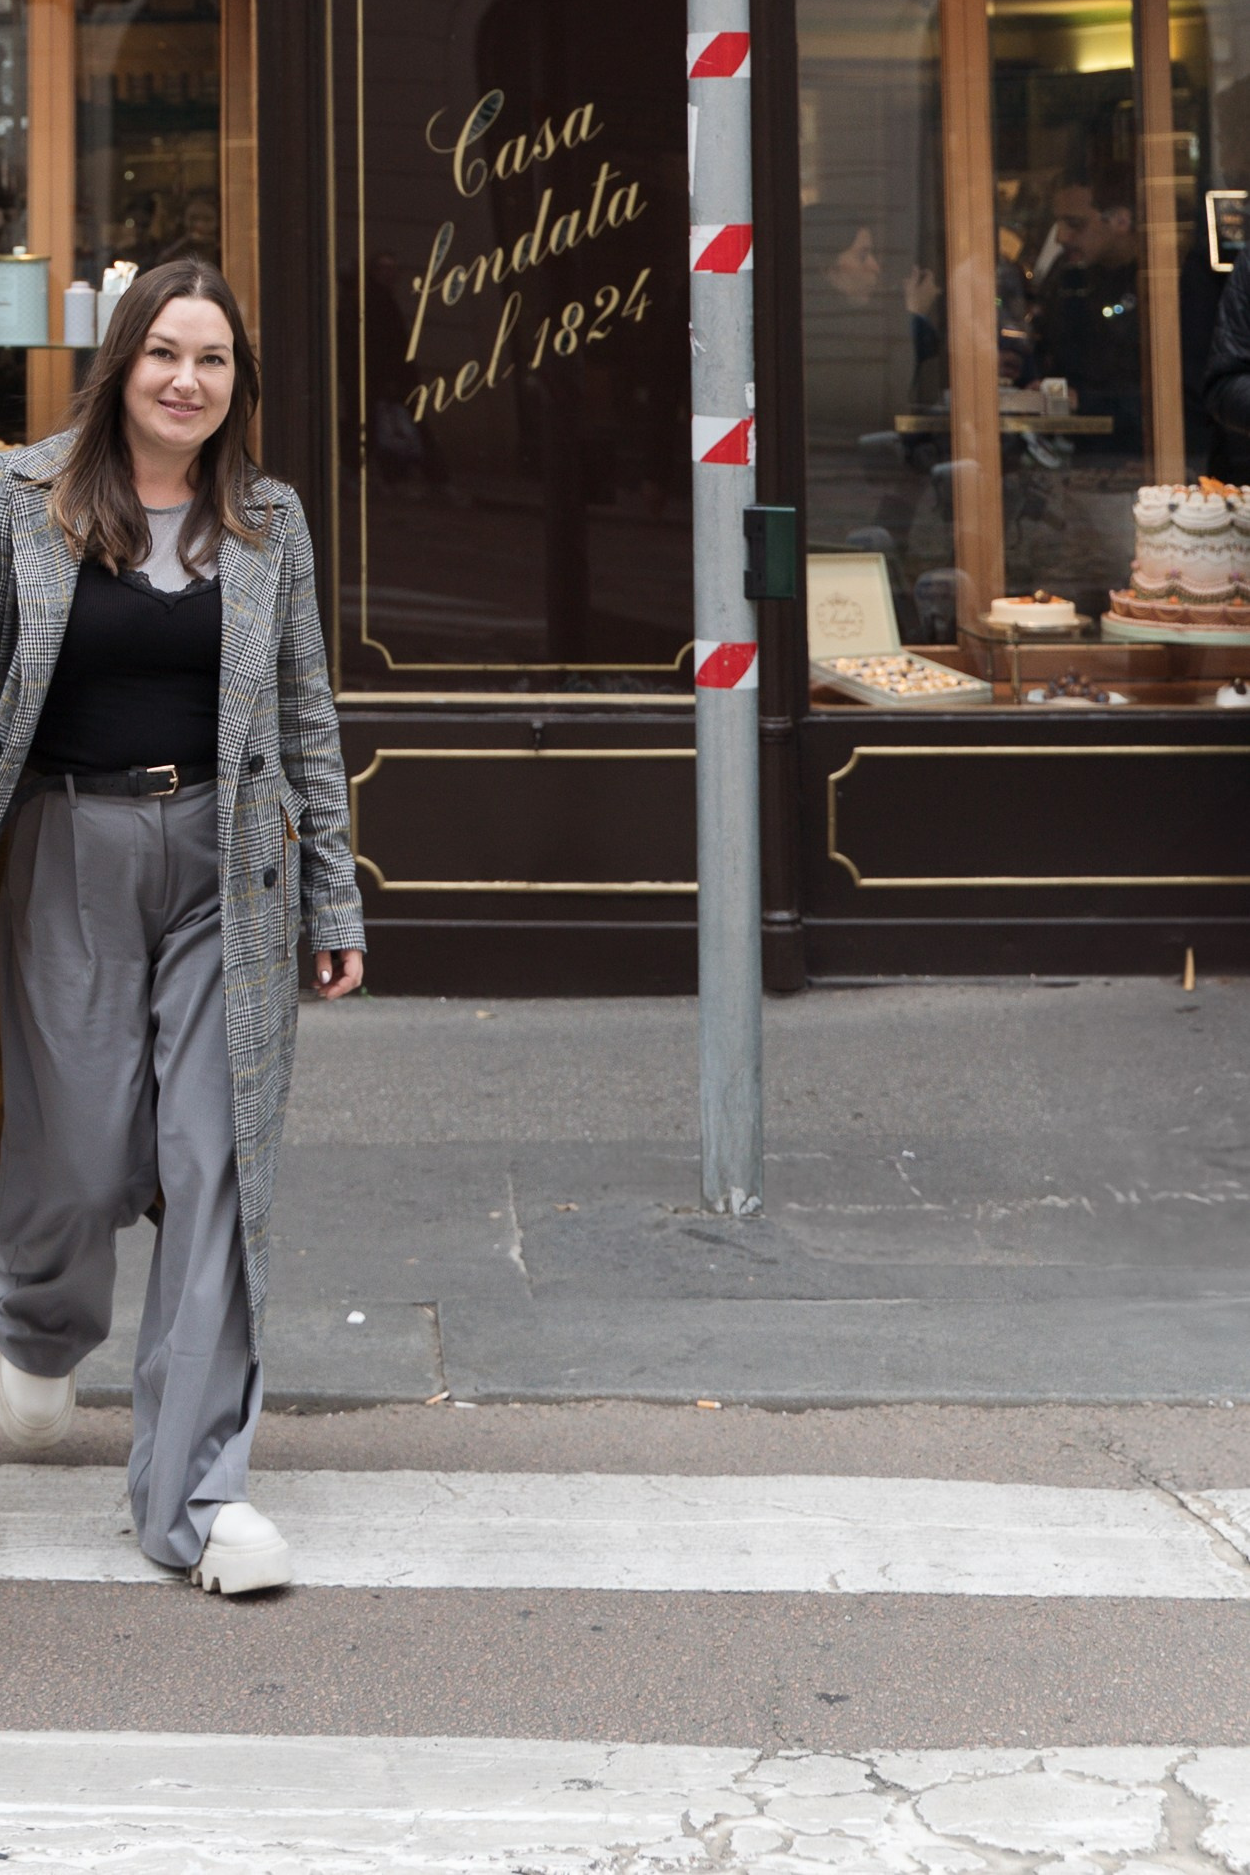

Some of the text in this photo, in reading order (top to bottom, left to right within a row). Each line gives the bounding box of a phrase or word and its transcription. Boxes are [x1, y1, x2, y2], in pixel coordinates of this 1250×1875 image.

[426, 88, 605, 198] Casa
[405, 162, 647, 363] fondata
[405, 268, 653, 423] nel 1824
